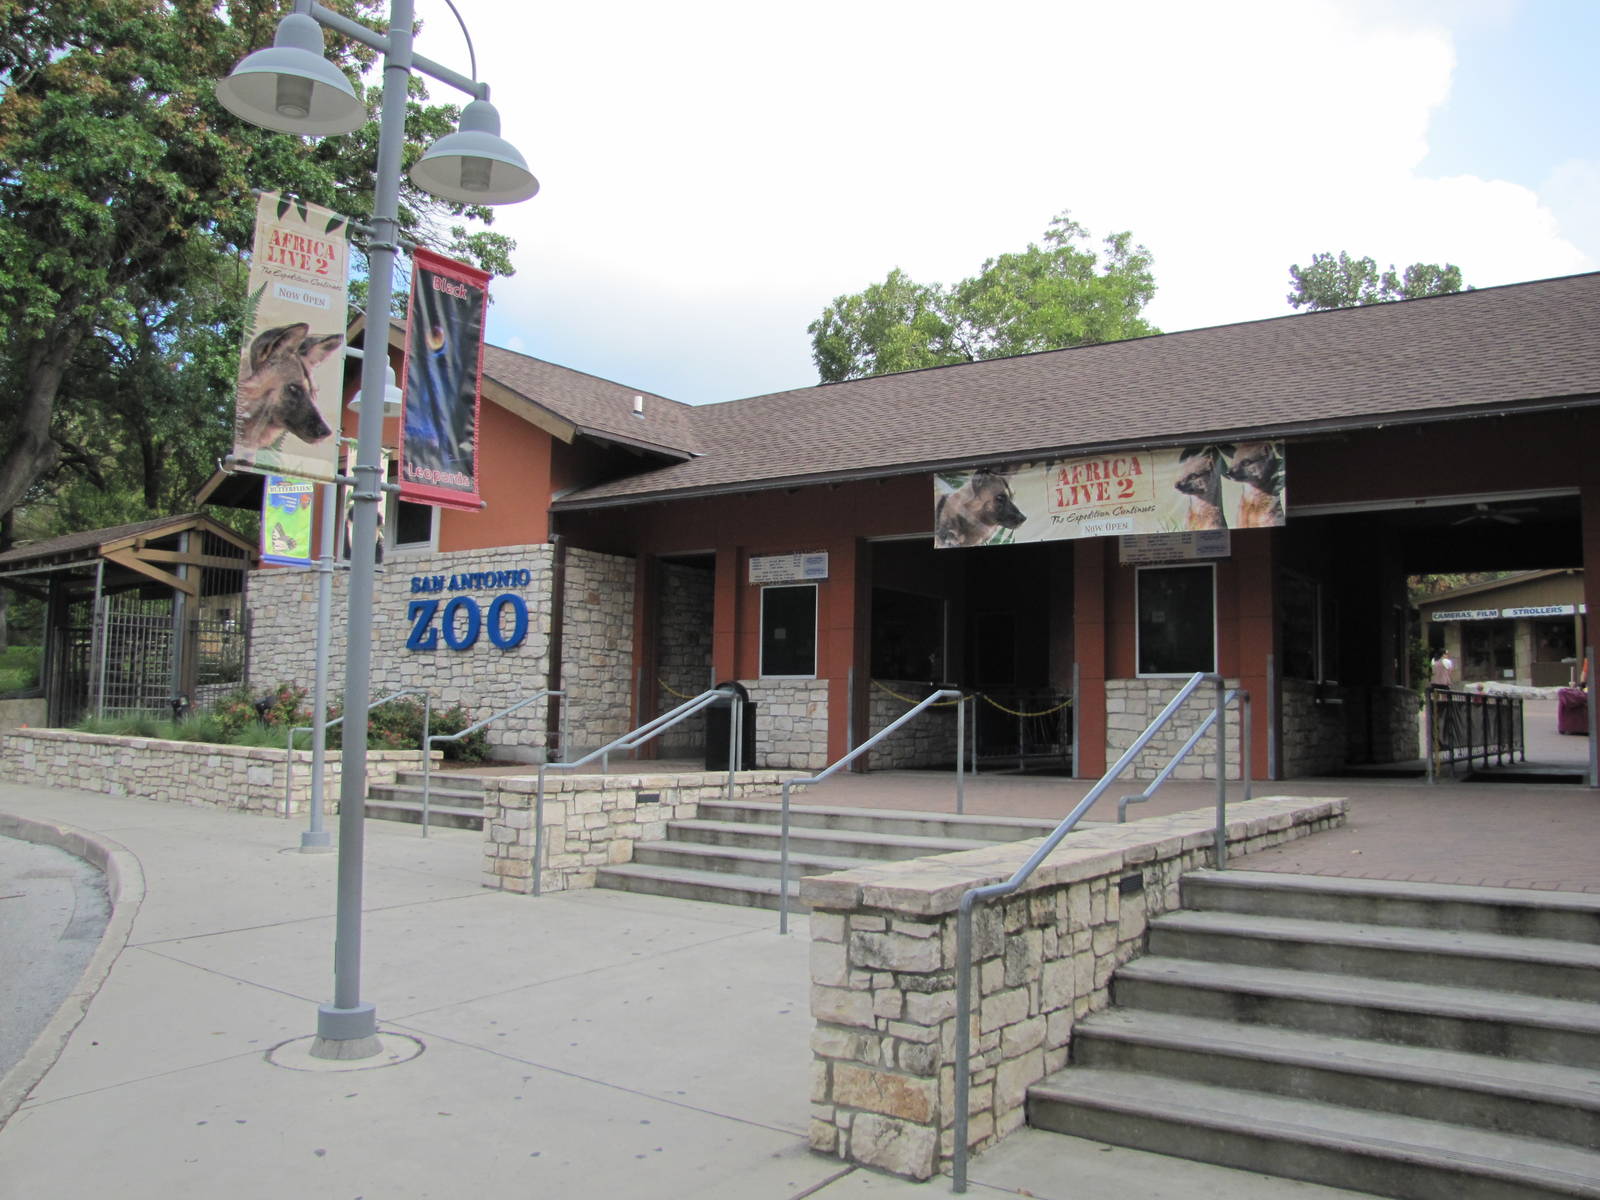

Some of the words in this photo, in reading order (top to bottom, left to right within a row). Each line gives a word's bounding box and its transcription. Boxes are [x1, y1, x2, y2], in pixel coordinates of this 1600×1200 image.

[270, 230, 336, 260] AFRICA
[262, 266, 273, 275] The
[267, 245, 311, 271] LIVE
[315, 258, 329, 275] 2
[433, 276, 467, 299] Black
[408, 463, 471, 487] Leopards
[1055, 456, 1143, 487] AFRICA
[1055, 481, 1111, 507] LIVE
[1116, 478, 1136, 499] 2
[1051, 515, 1064, 525] The
[1066, 511, 1110, 525] Expedition
[1112, 505, 1156, 517] Continues
[411, 575, 446, 593] SAN
[447, 568, 532, 592] ANTONIO
[406, 593, 529, 652] ZOO
[1476, 609, 1497, 617] FILM
[1513, 606, 1563, 615] STROLLERS
